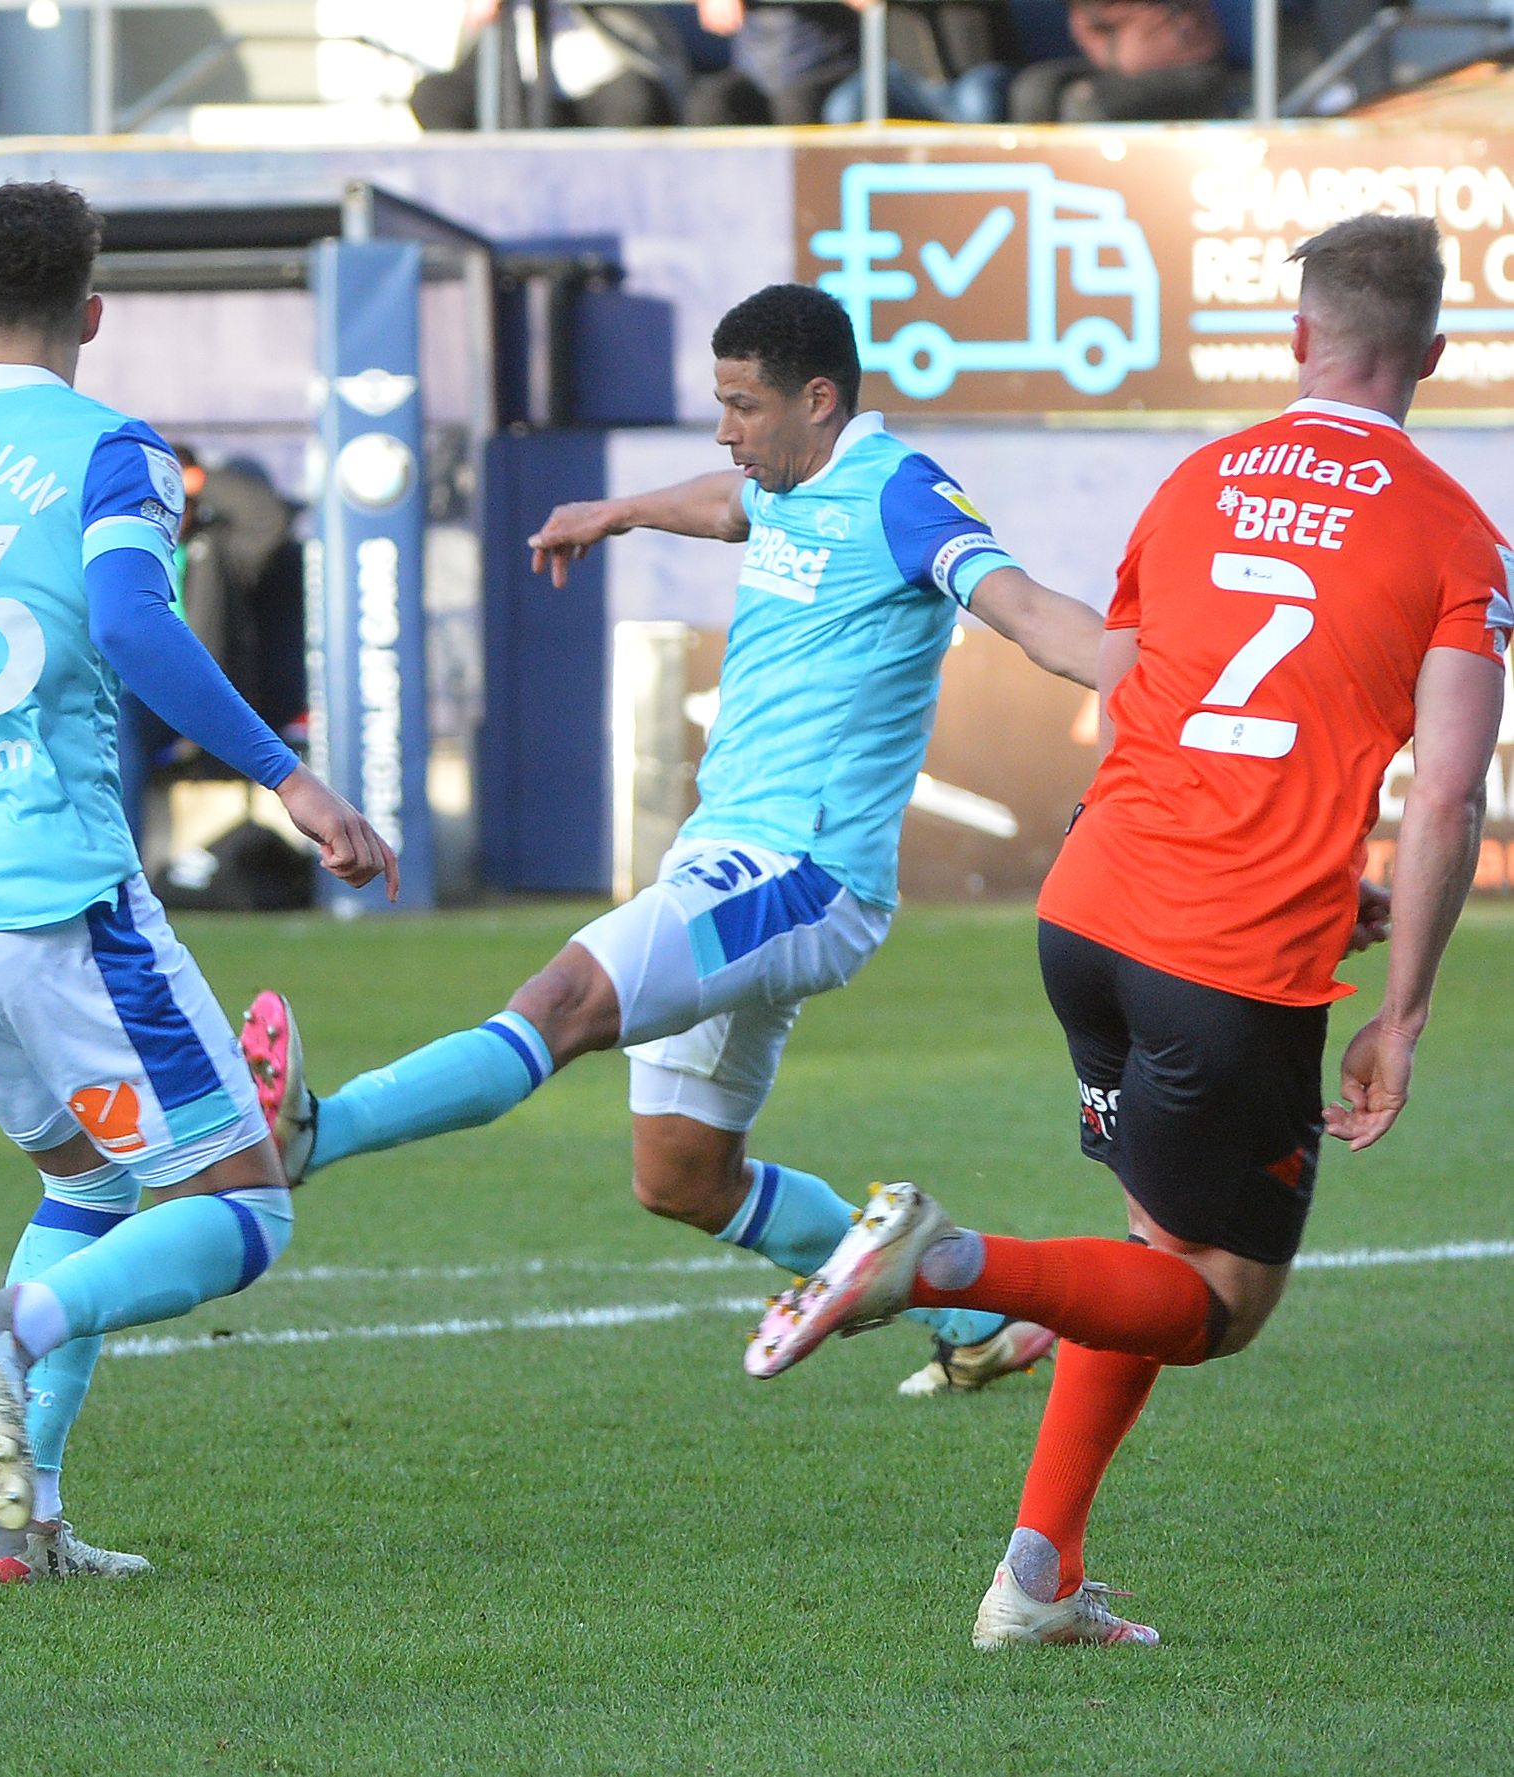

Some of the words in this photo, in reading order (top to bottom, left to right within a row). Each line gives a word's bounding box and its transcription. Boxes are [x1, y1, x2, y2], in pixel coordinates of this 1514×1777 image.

[1219, 444, 1344, 486] utilita
[1234, 496, 1354, 550] BREE
[742, 524, 832, 586] 2Red
[1179, 552, 1318, 759] 2
